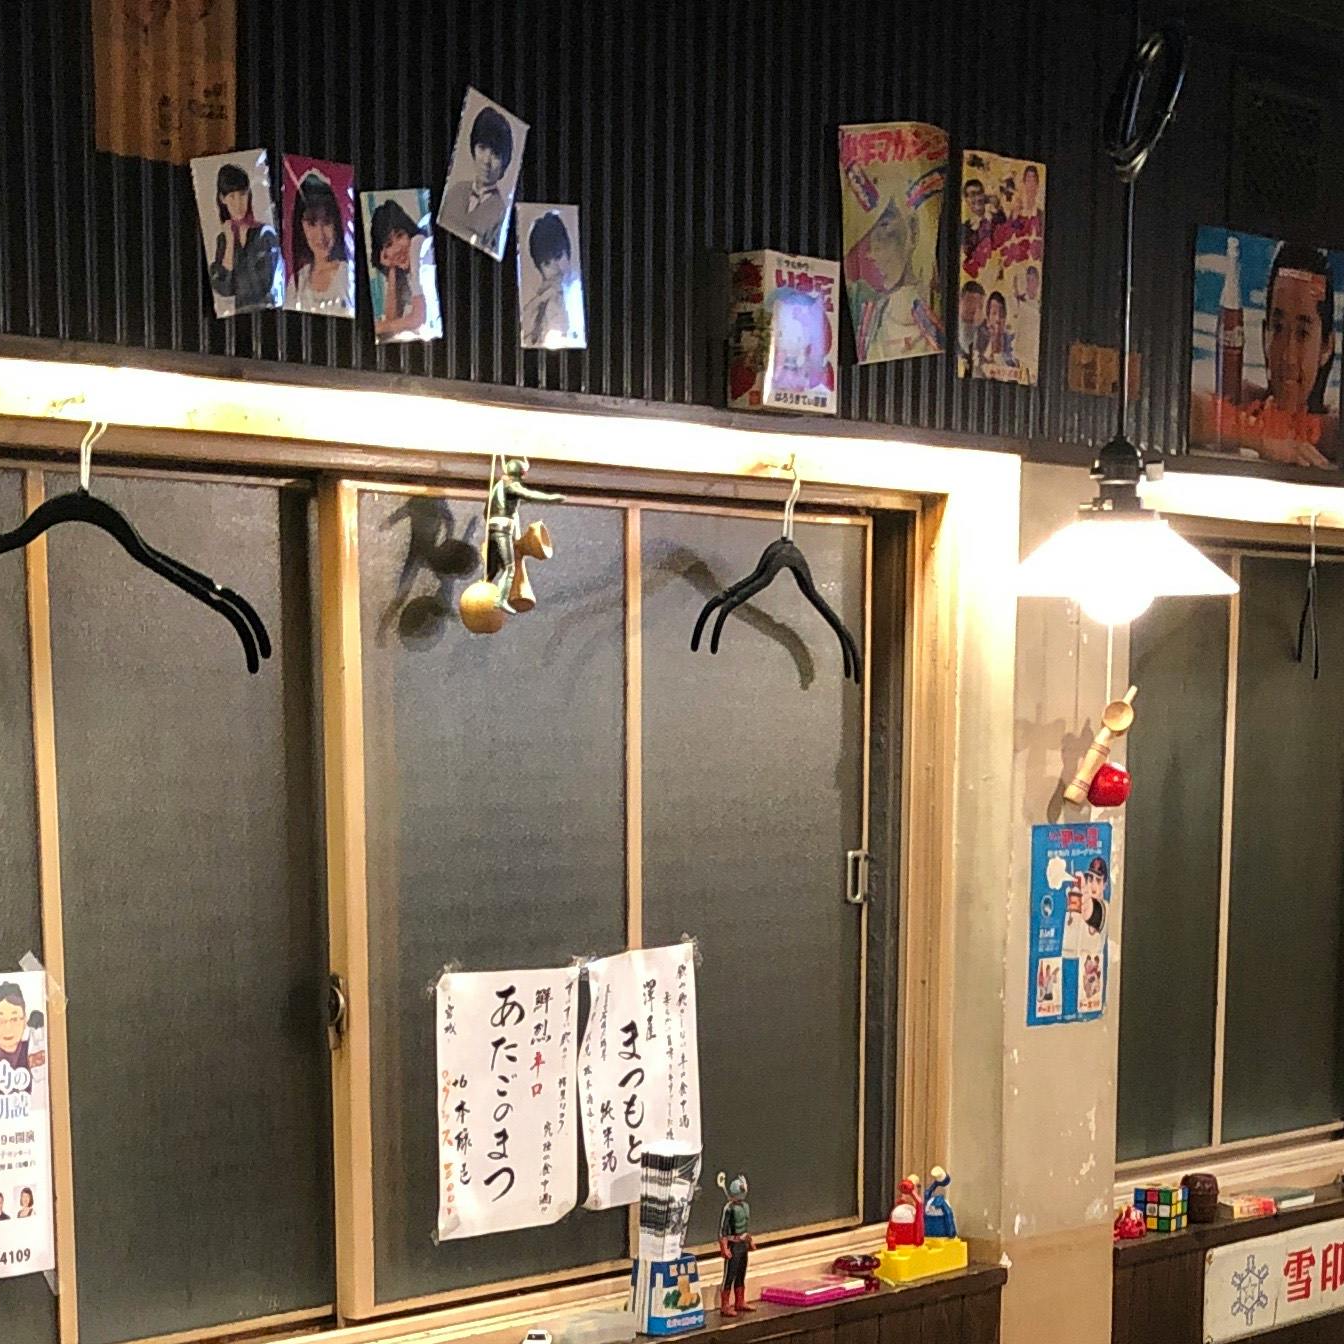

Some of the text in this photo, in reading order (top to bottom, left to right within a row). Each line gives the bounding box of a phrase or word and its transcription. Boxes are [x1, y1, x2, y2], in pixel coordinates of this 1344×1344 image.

[483, 985, 526, 1203] あたごのまつ
[617, 1020, 645, 1165] まつもと
